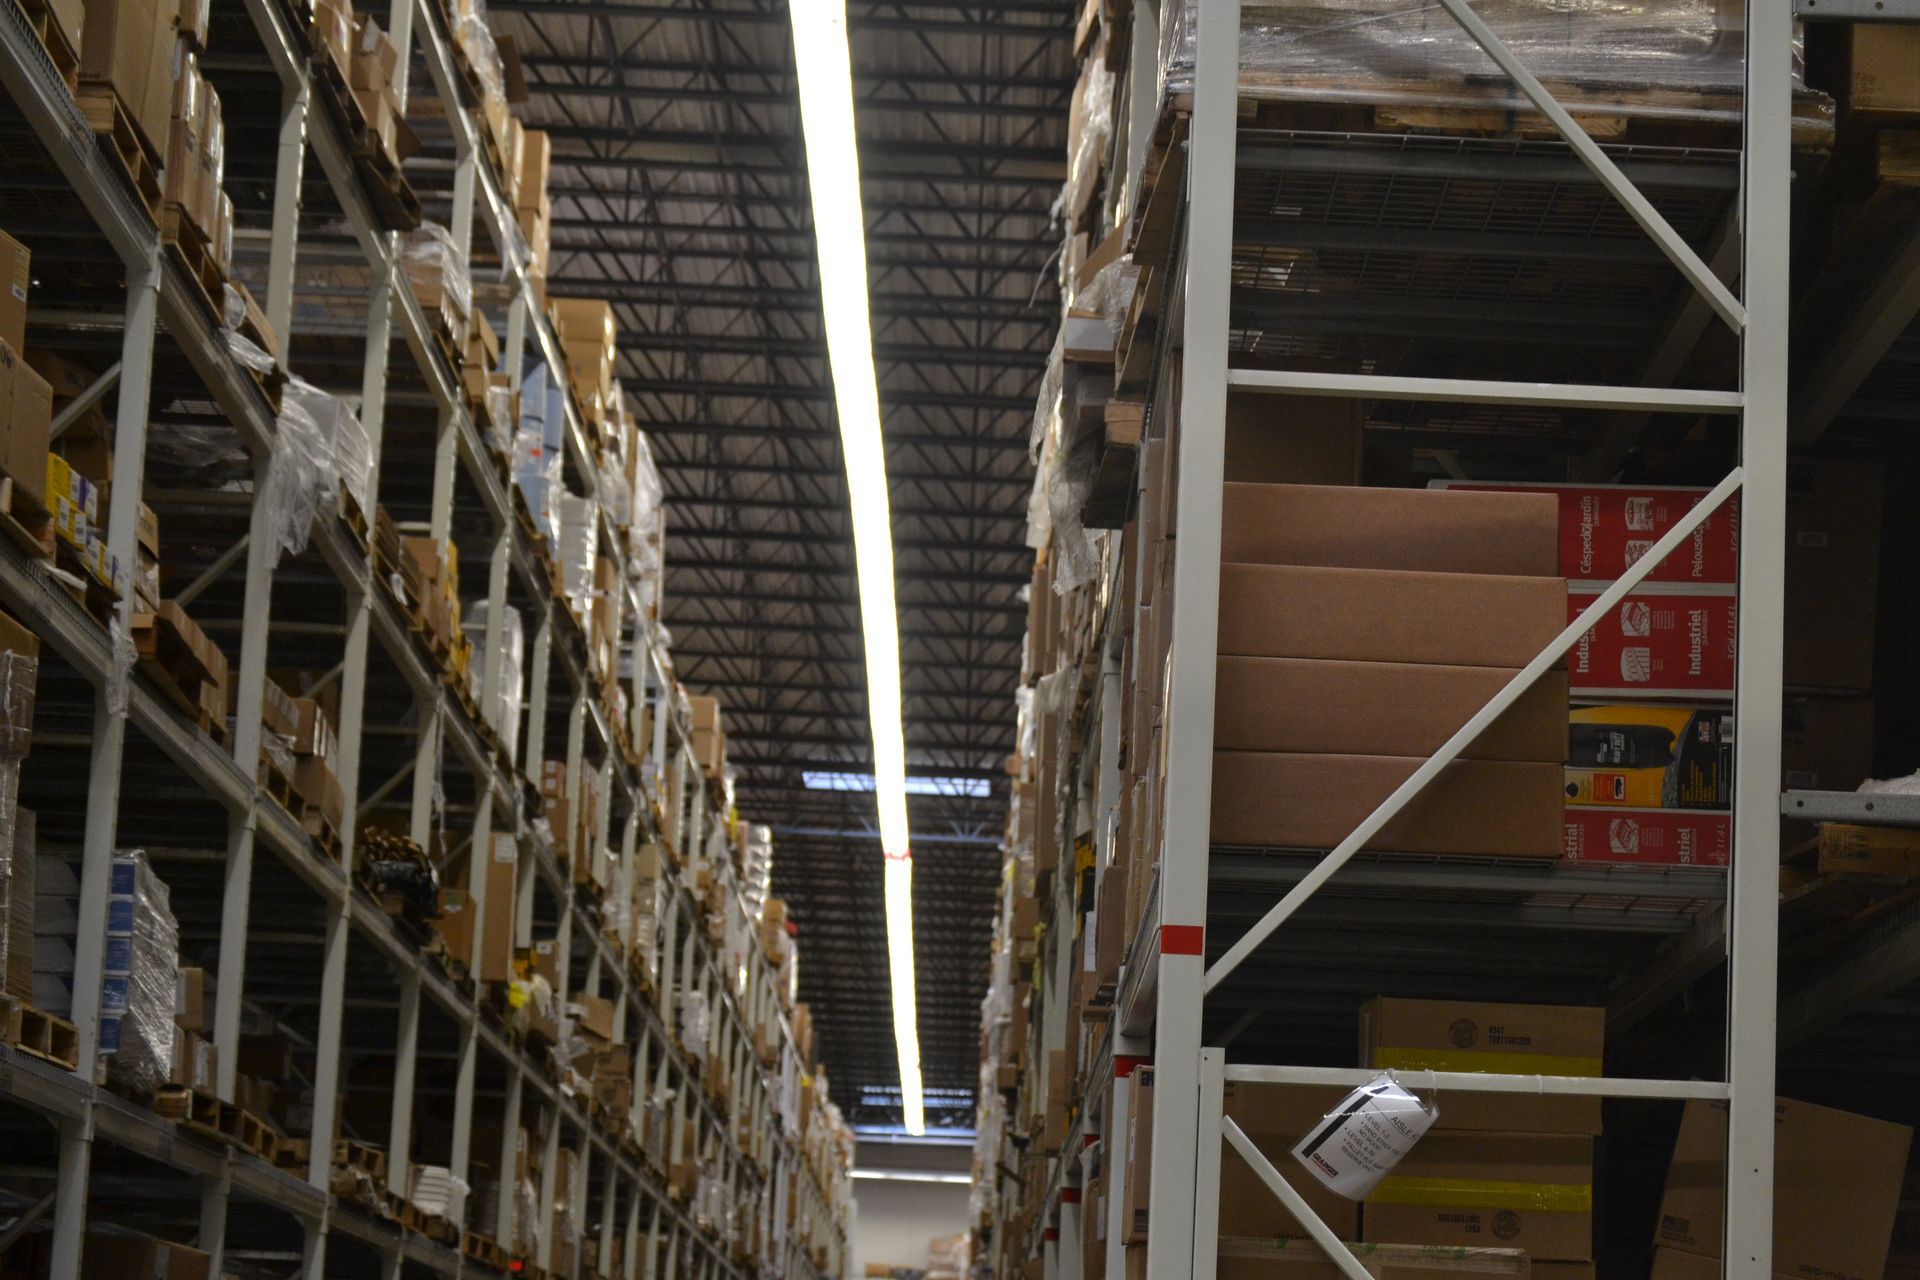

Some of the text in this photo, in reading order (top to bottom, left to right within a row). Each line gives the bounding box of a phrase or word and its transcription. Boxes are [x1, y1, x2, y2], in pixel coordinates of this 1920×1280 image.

[1580, 534, 1594, 574] Césped
[1691, 536, 1703, 577] Pelouse
[1576, 608, 1589, 673] Indusl
[1688, 609, 1701, 675] Industriel
[1365, 1113, 1380, 1131] LEVEL
[1391, 1116, 1414, 1137] AISLE
[1347, 1130, 1363, 1148] LEVEL
[1312, 1152, 1339, 1177] GRAINGER
